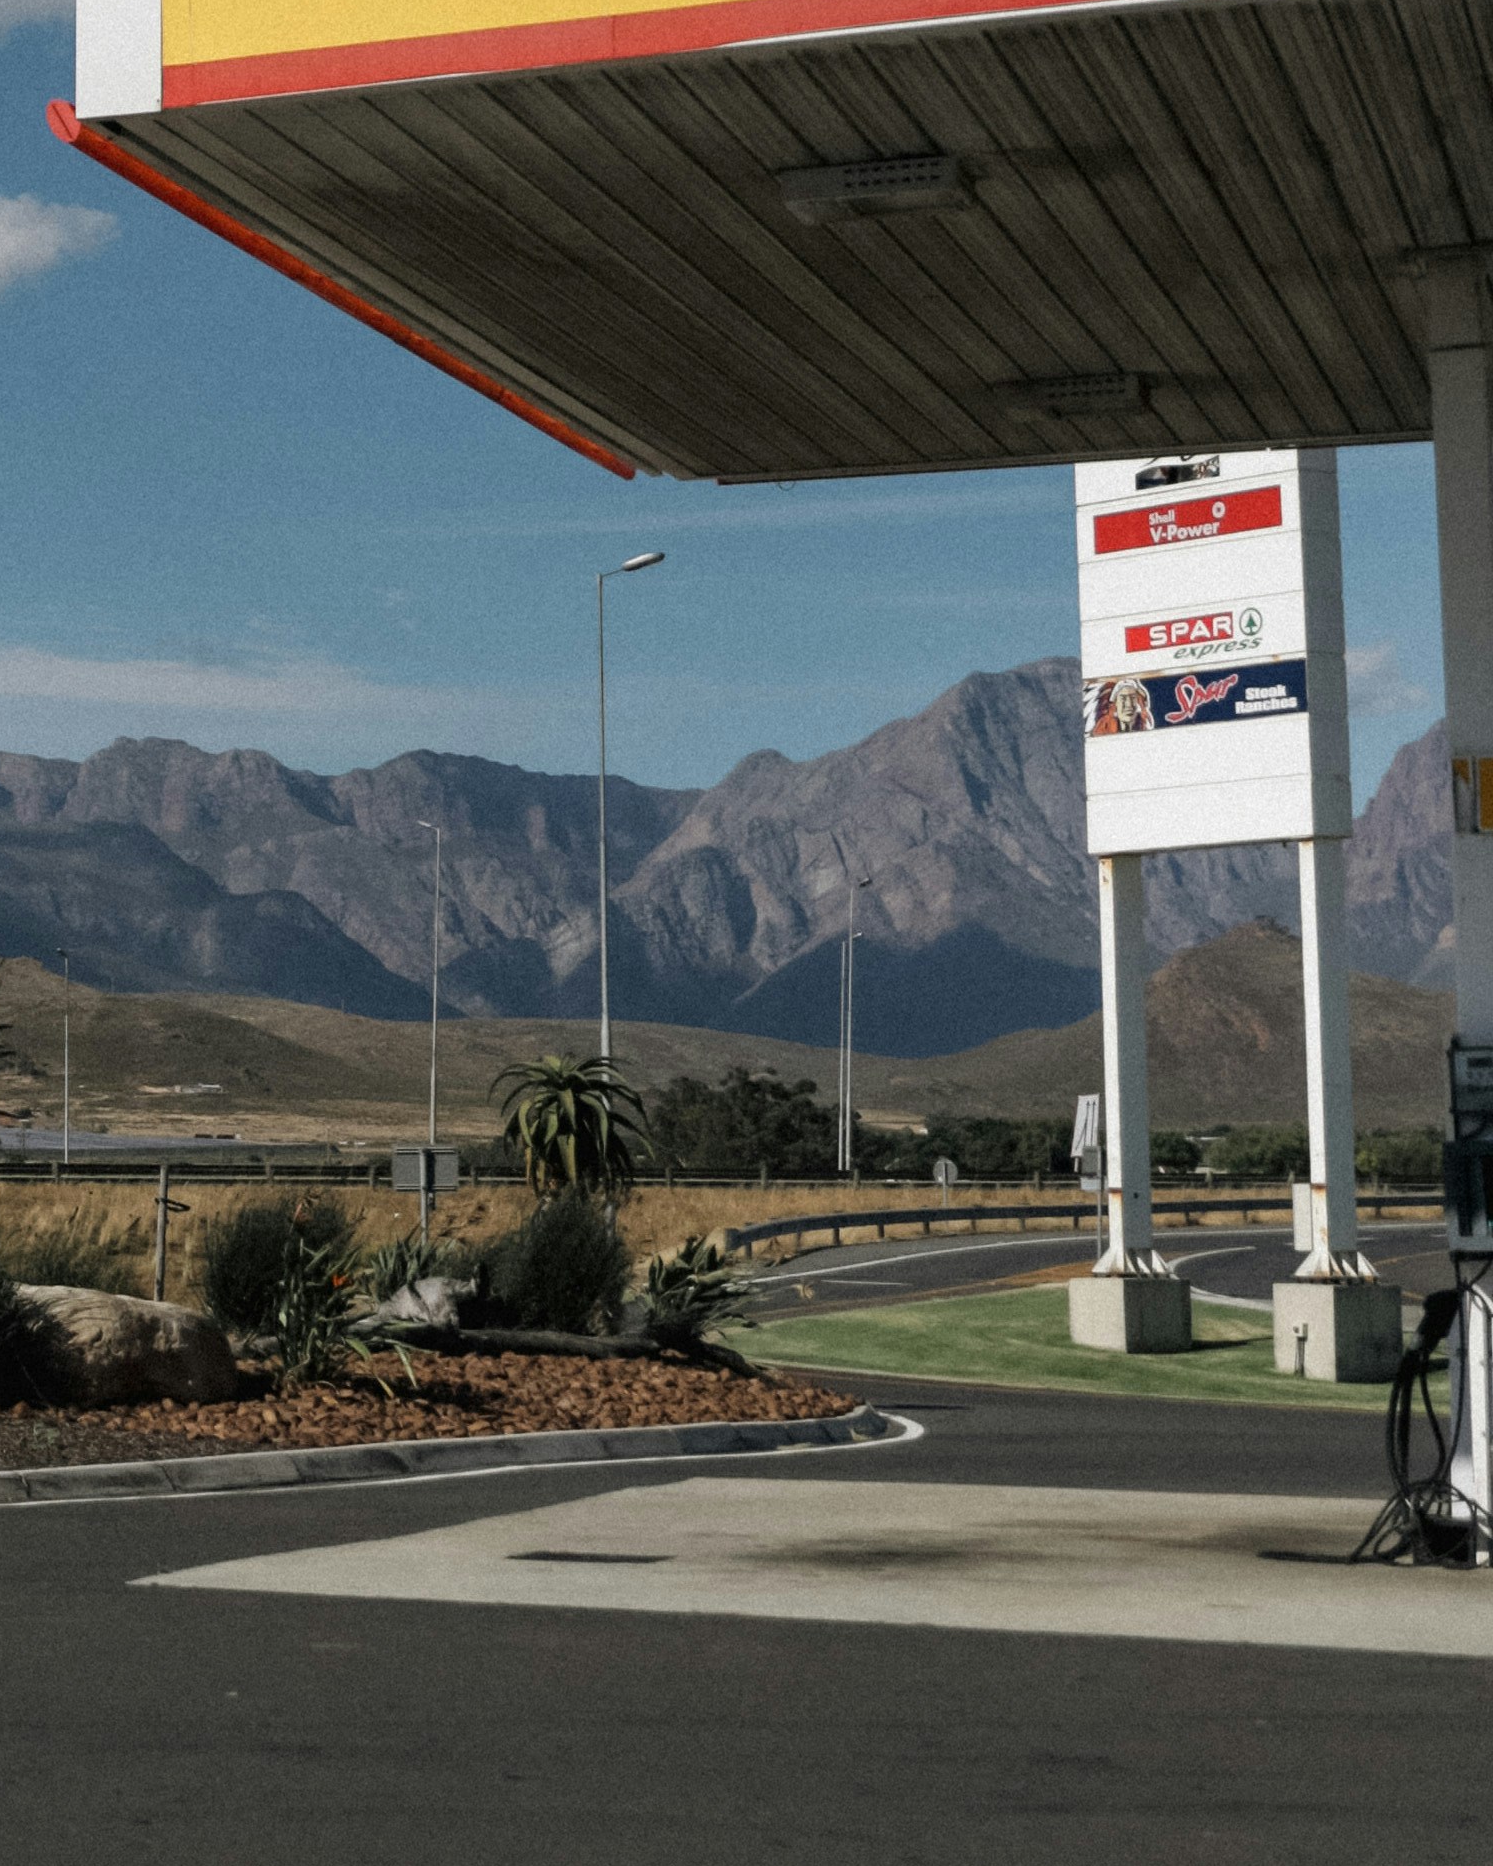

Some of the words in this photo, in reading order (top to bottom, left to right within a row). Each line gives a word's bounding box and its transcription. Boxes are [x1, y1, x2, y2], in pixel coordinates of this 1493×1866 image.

[1149, 509, 1175, 525] Shell
[1150, 521, 1221, 544] V-Power
[1149, 615, 1232, 647] SPAR
[1173, 637, 1262, 660] express
[1165, 673, 1238, 723] Spur
[1245, 684, 1287, 700] Steak
